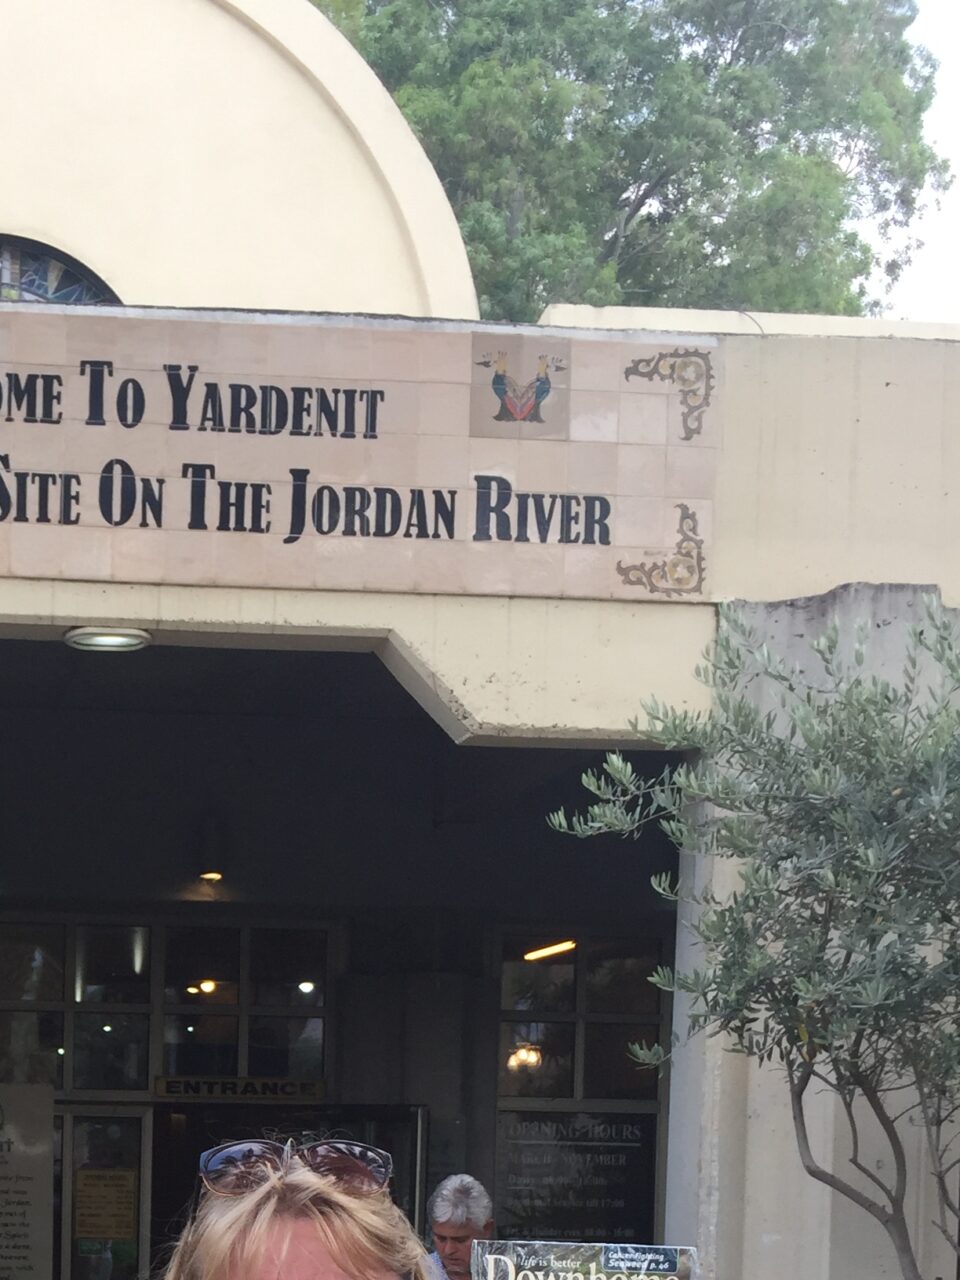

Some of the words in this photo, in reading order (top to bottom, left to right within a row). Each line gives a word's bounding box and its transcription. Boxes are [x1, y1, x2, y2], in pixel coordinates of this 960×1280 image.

[80, 360, 146, 430] TO
[163, 364, 385, 440] YARDENIT
[99, 458, 165, 529] ON
[182, 463, 272, 534] THE
[283, 468, 459, 545] JORDAN
[473, 474, 611, 546] RIVER
[165, 1080, 317, 1096] ENTRANCE
[510, 1121, 584, 1138] OPENING
[589, 1124, 641, 1140] HOURS
[521, 1255, 539, 1268] life
[540, 1258, 547, 1267] is
[551, 1255, 581, 1267] better
